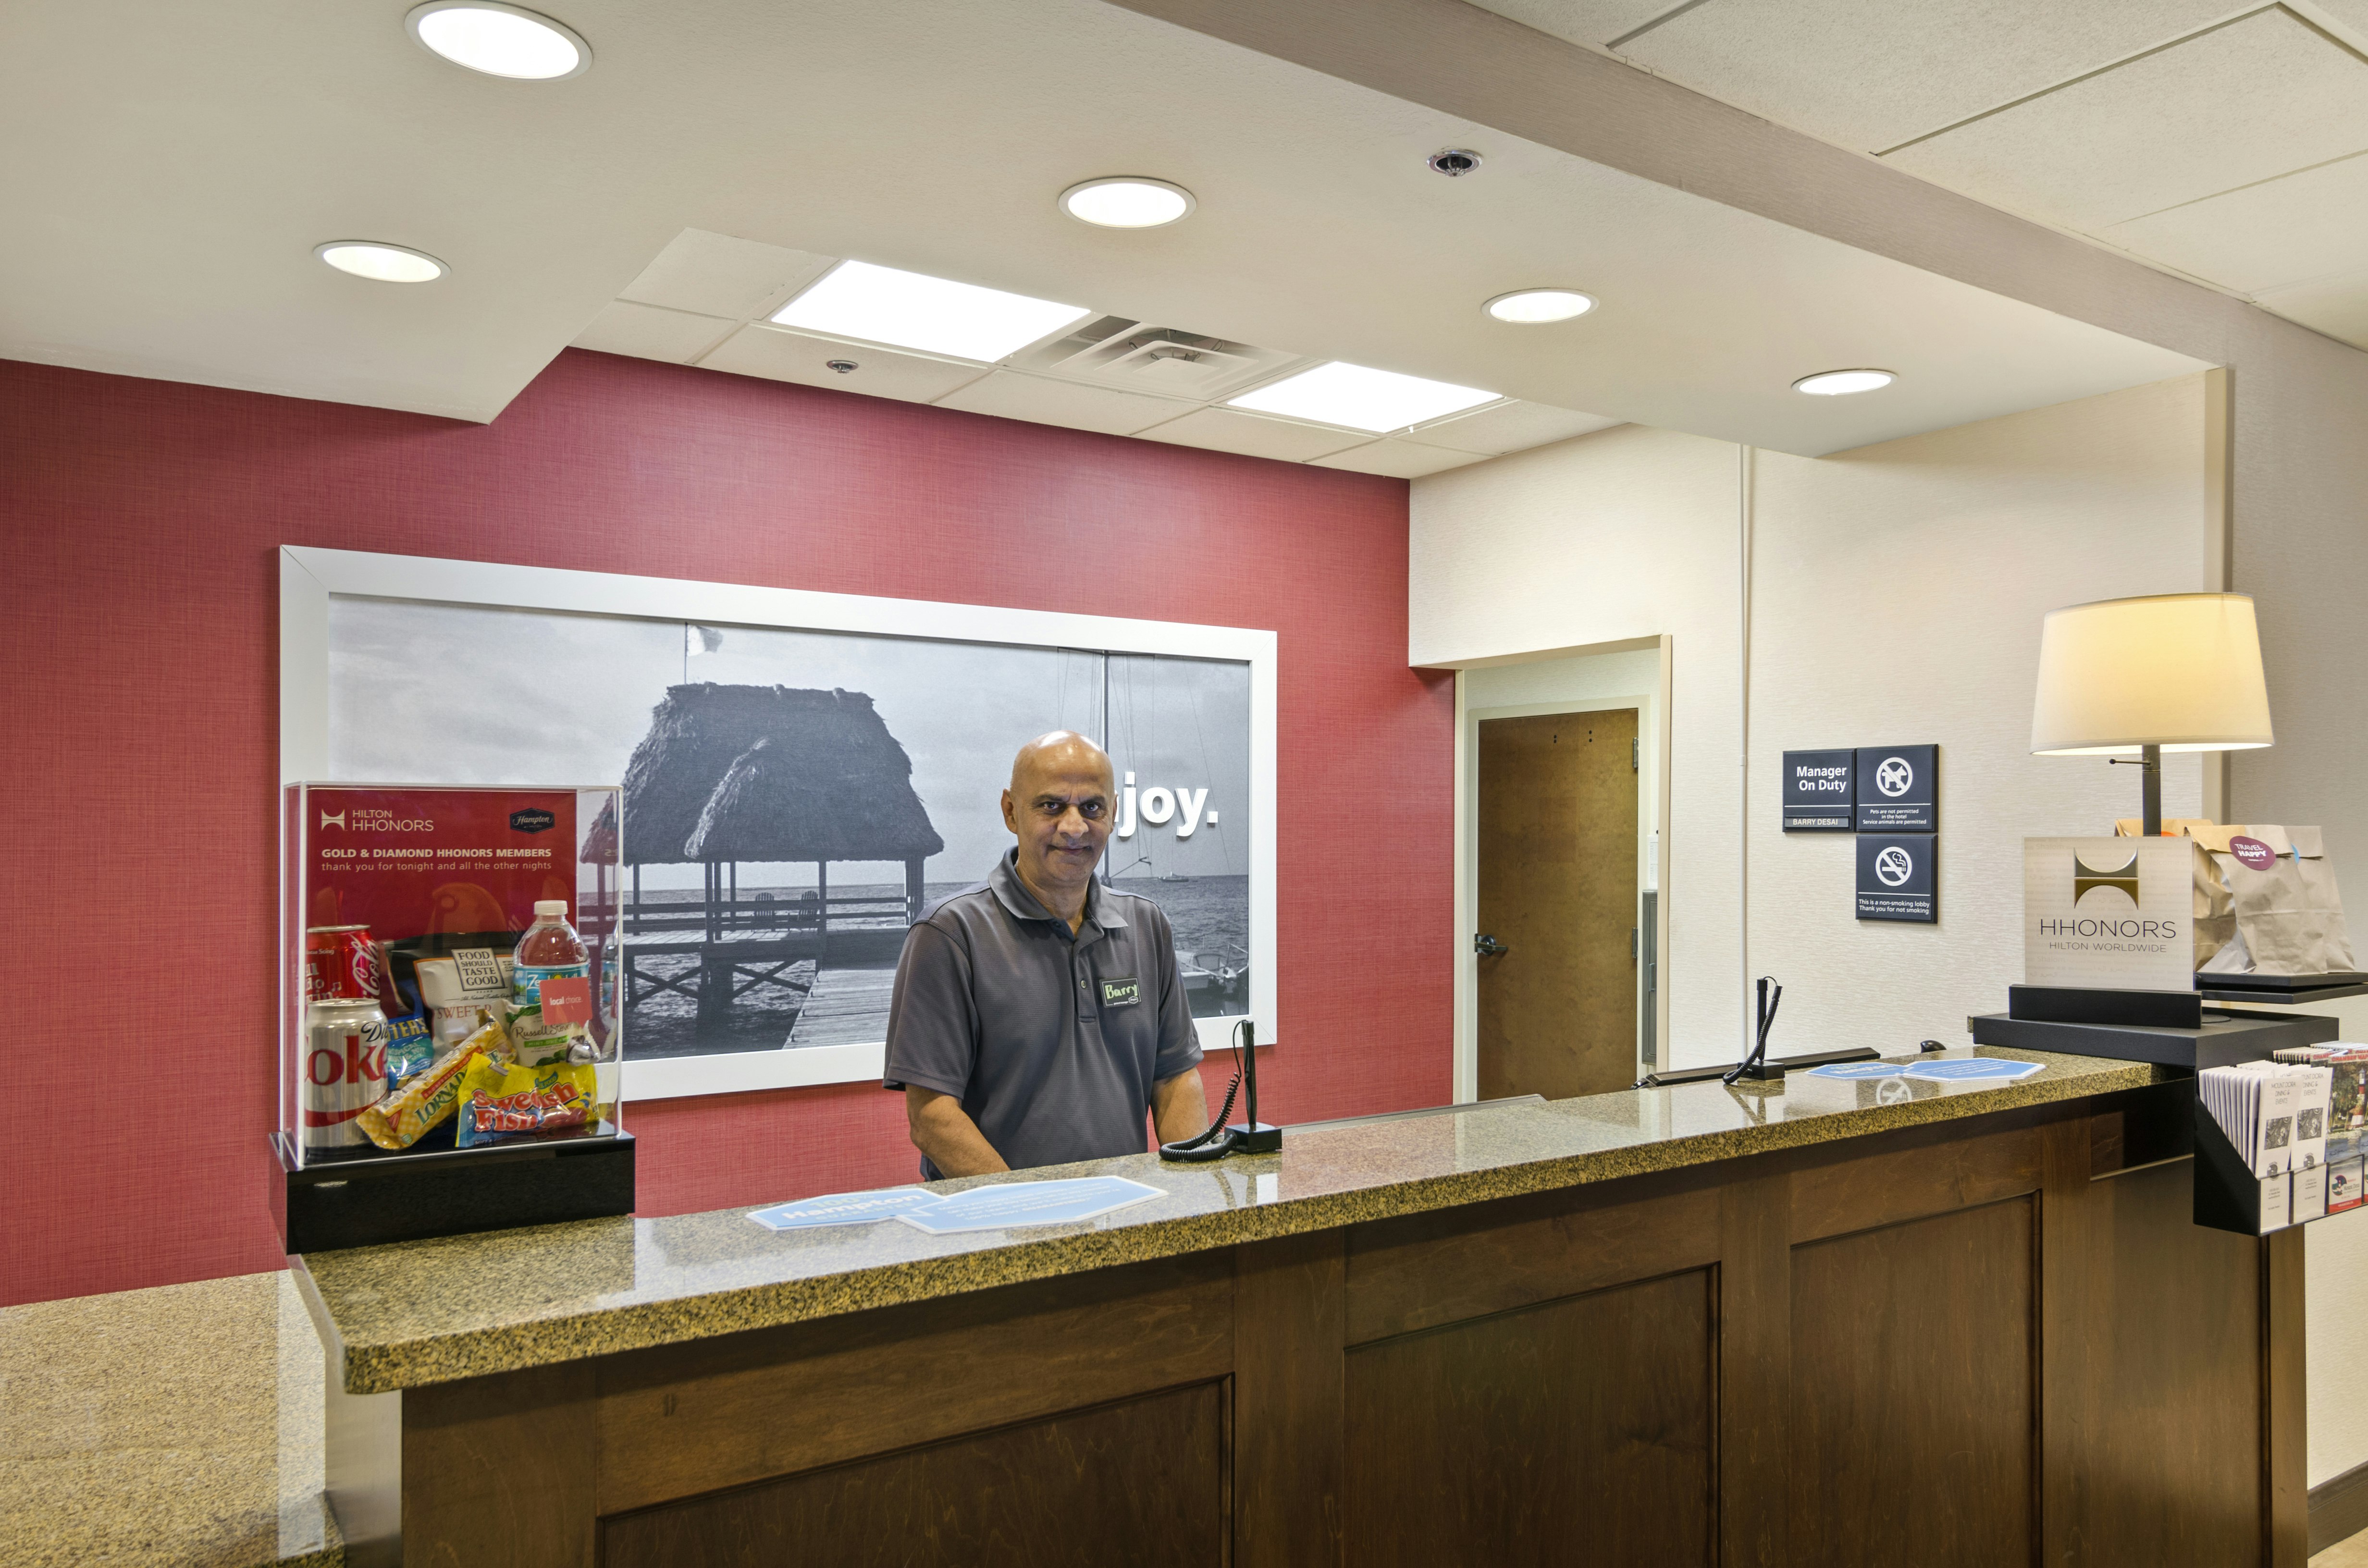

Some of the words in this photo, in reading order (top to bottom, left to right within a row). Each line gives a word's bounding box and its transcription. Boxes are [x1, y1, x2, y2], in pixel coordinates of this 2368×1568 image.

[1797, 766, 1847, 779] Manager
[1799, 780, 1815, 791] On
[1818, 780, 1847, 793] Duty
[1115, 772, 1218, 837] joy.
[353, 810, 392, 818] HILTON
[513, 815, 553, 825] Hampton
[353, 820, 434, 832] HHONORS
[321, 849, 357, 858] GOLD
[360, 849, 370, 858] &
[373, 849, 433, 858] DIAMOND
[437, 849, 493, 858] HHONORS
[496, 849, 552, 857] MEMBERS
[356, 864, 374, 872] you
[378, 862, 393, 870] for
[397, 862, 433, 872] tonight
[437, 862, 456, 870] and
[522, 862, 552, 871] nights
[2040, 919, 2177, 939] HHONORS
[2049, 942, 2089, 950] HILTON
[2093, 943, 2167, 953] WORLDWIDE
[458, 951, 490, 960] FOOD
[463, 967, 496, 976] TASTE
[466, 976, 498, 985] GOOD
[1105, 984, 1138, 999] Barry
[550, 996, 565, 1005] local
[387, 1018, 429, 1041] TERS
[512, 1025, 550, 1040] Russell
[305, 1035, 388, 1086] oke
[415, 1080, 458, 1126] LORNA
[475, 1108, 538, 1132] Fish
[782, 1195, 923, 1219] Hampton
[815, 1202, 915, 1220] GUARANTEE
